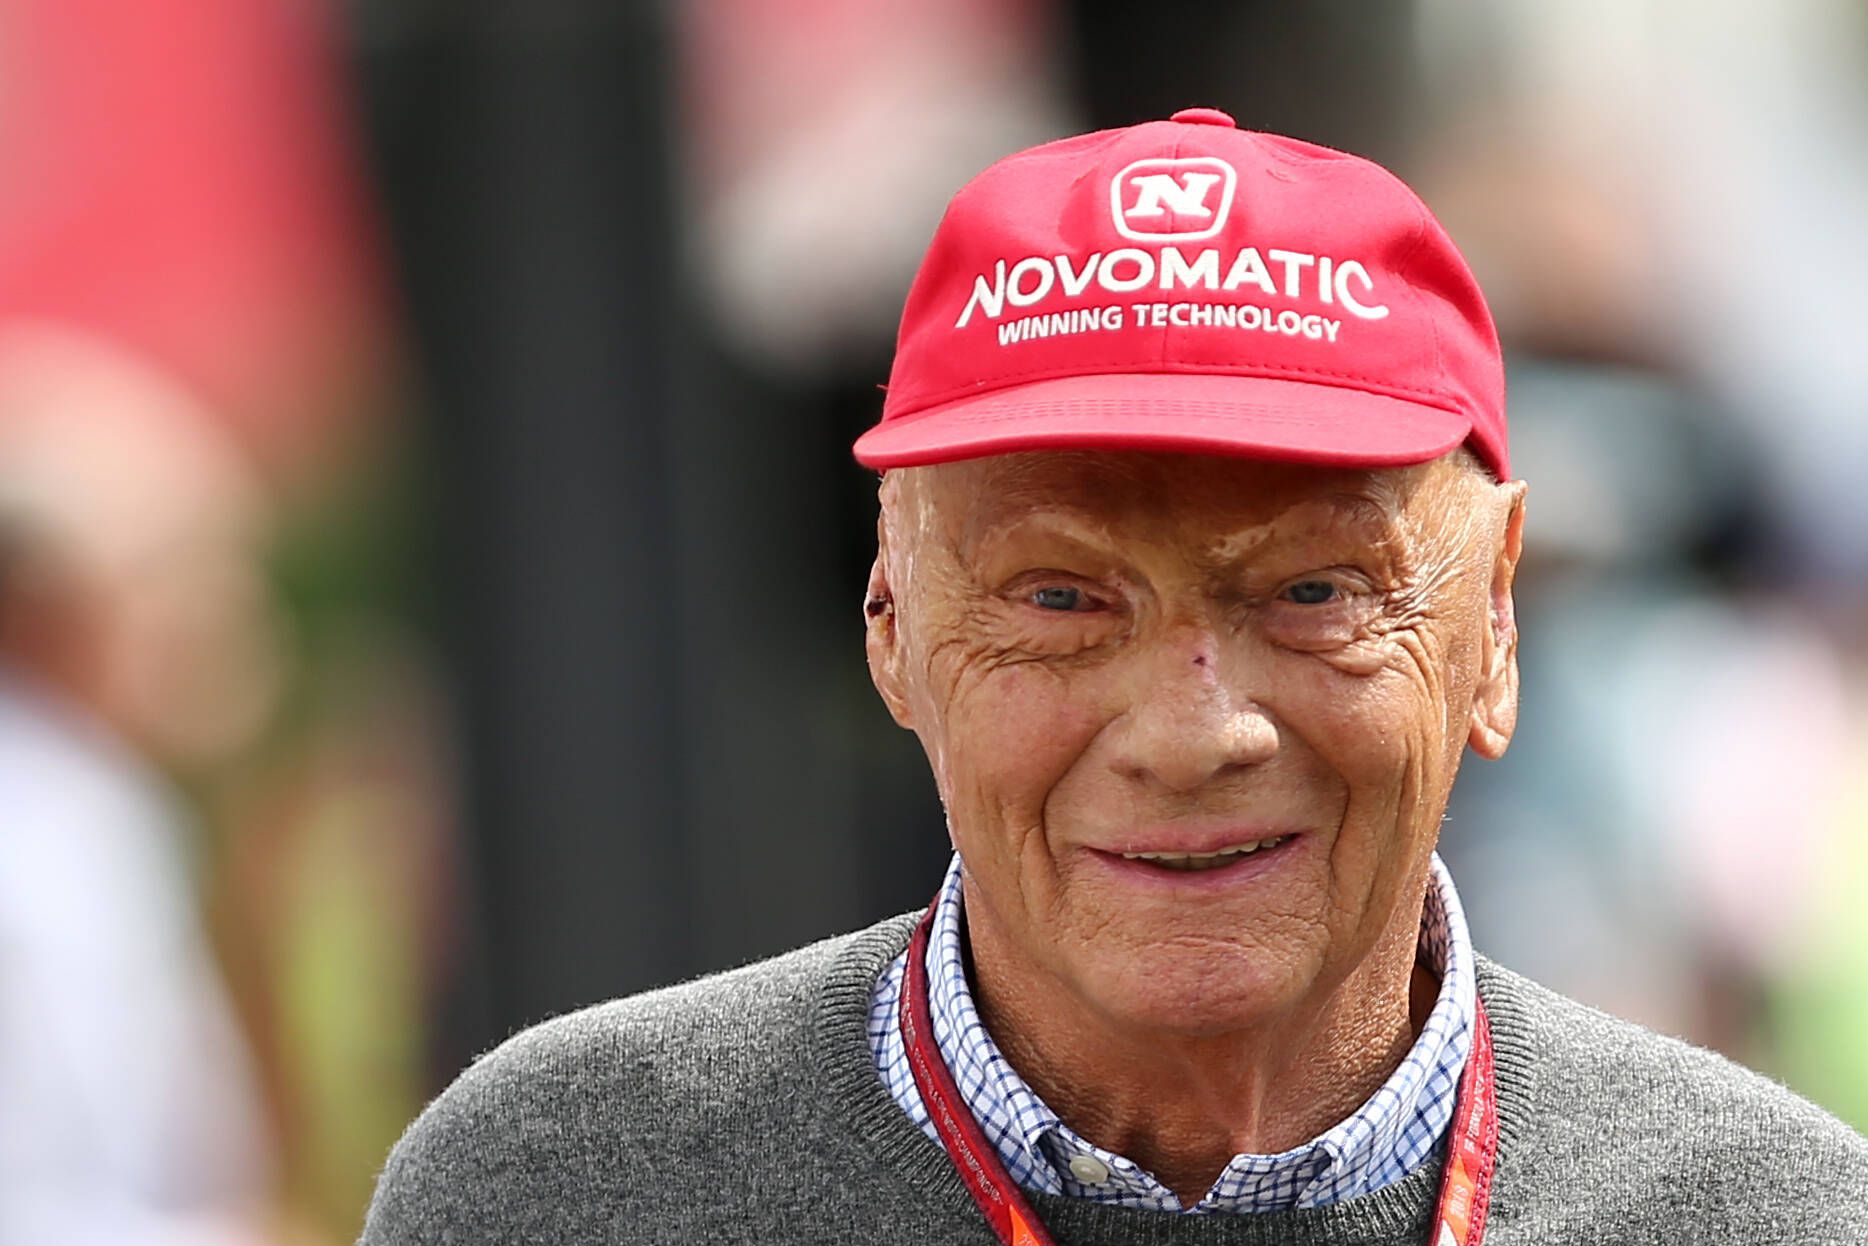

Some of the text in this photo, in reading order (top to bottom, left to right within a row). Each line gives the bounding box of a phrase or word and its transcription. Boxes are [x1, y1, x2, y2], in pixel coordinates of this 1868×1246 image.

[1125, 173, 1220, 216] N
[955, 247, 1390, 328] NOVOMATIC
[999, 303, 1341, 344] WINNING TECHNOLOGY
